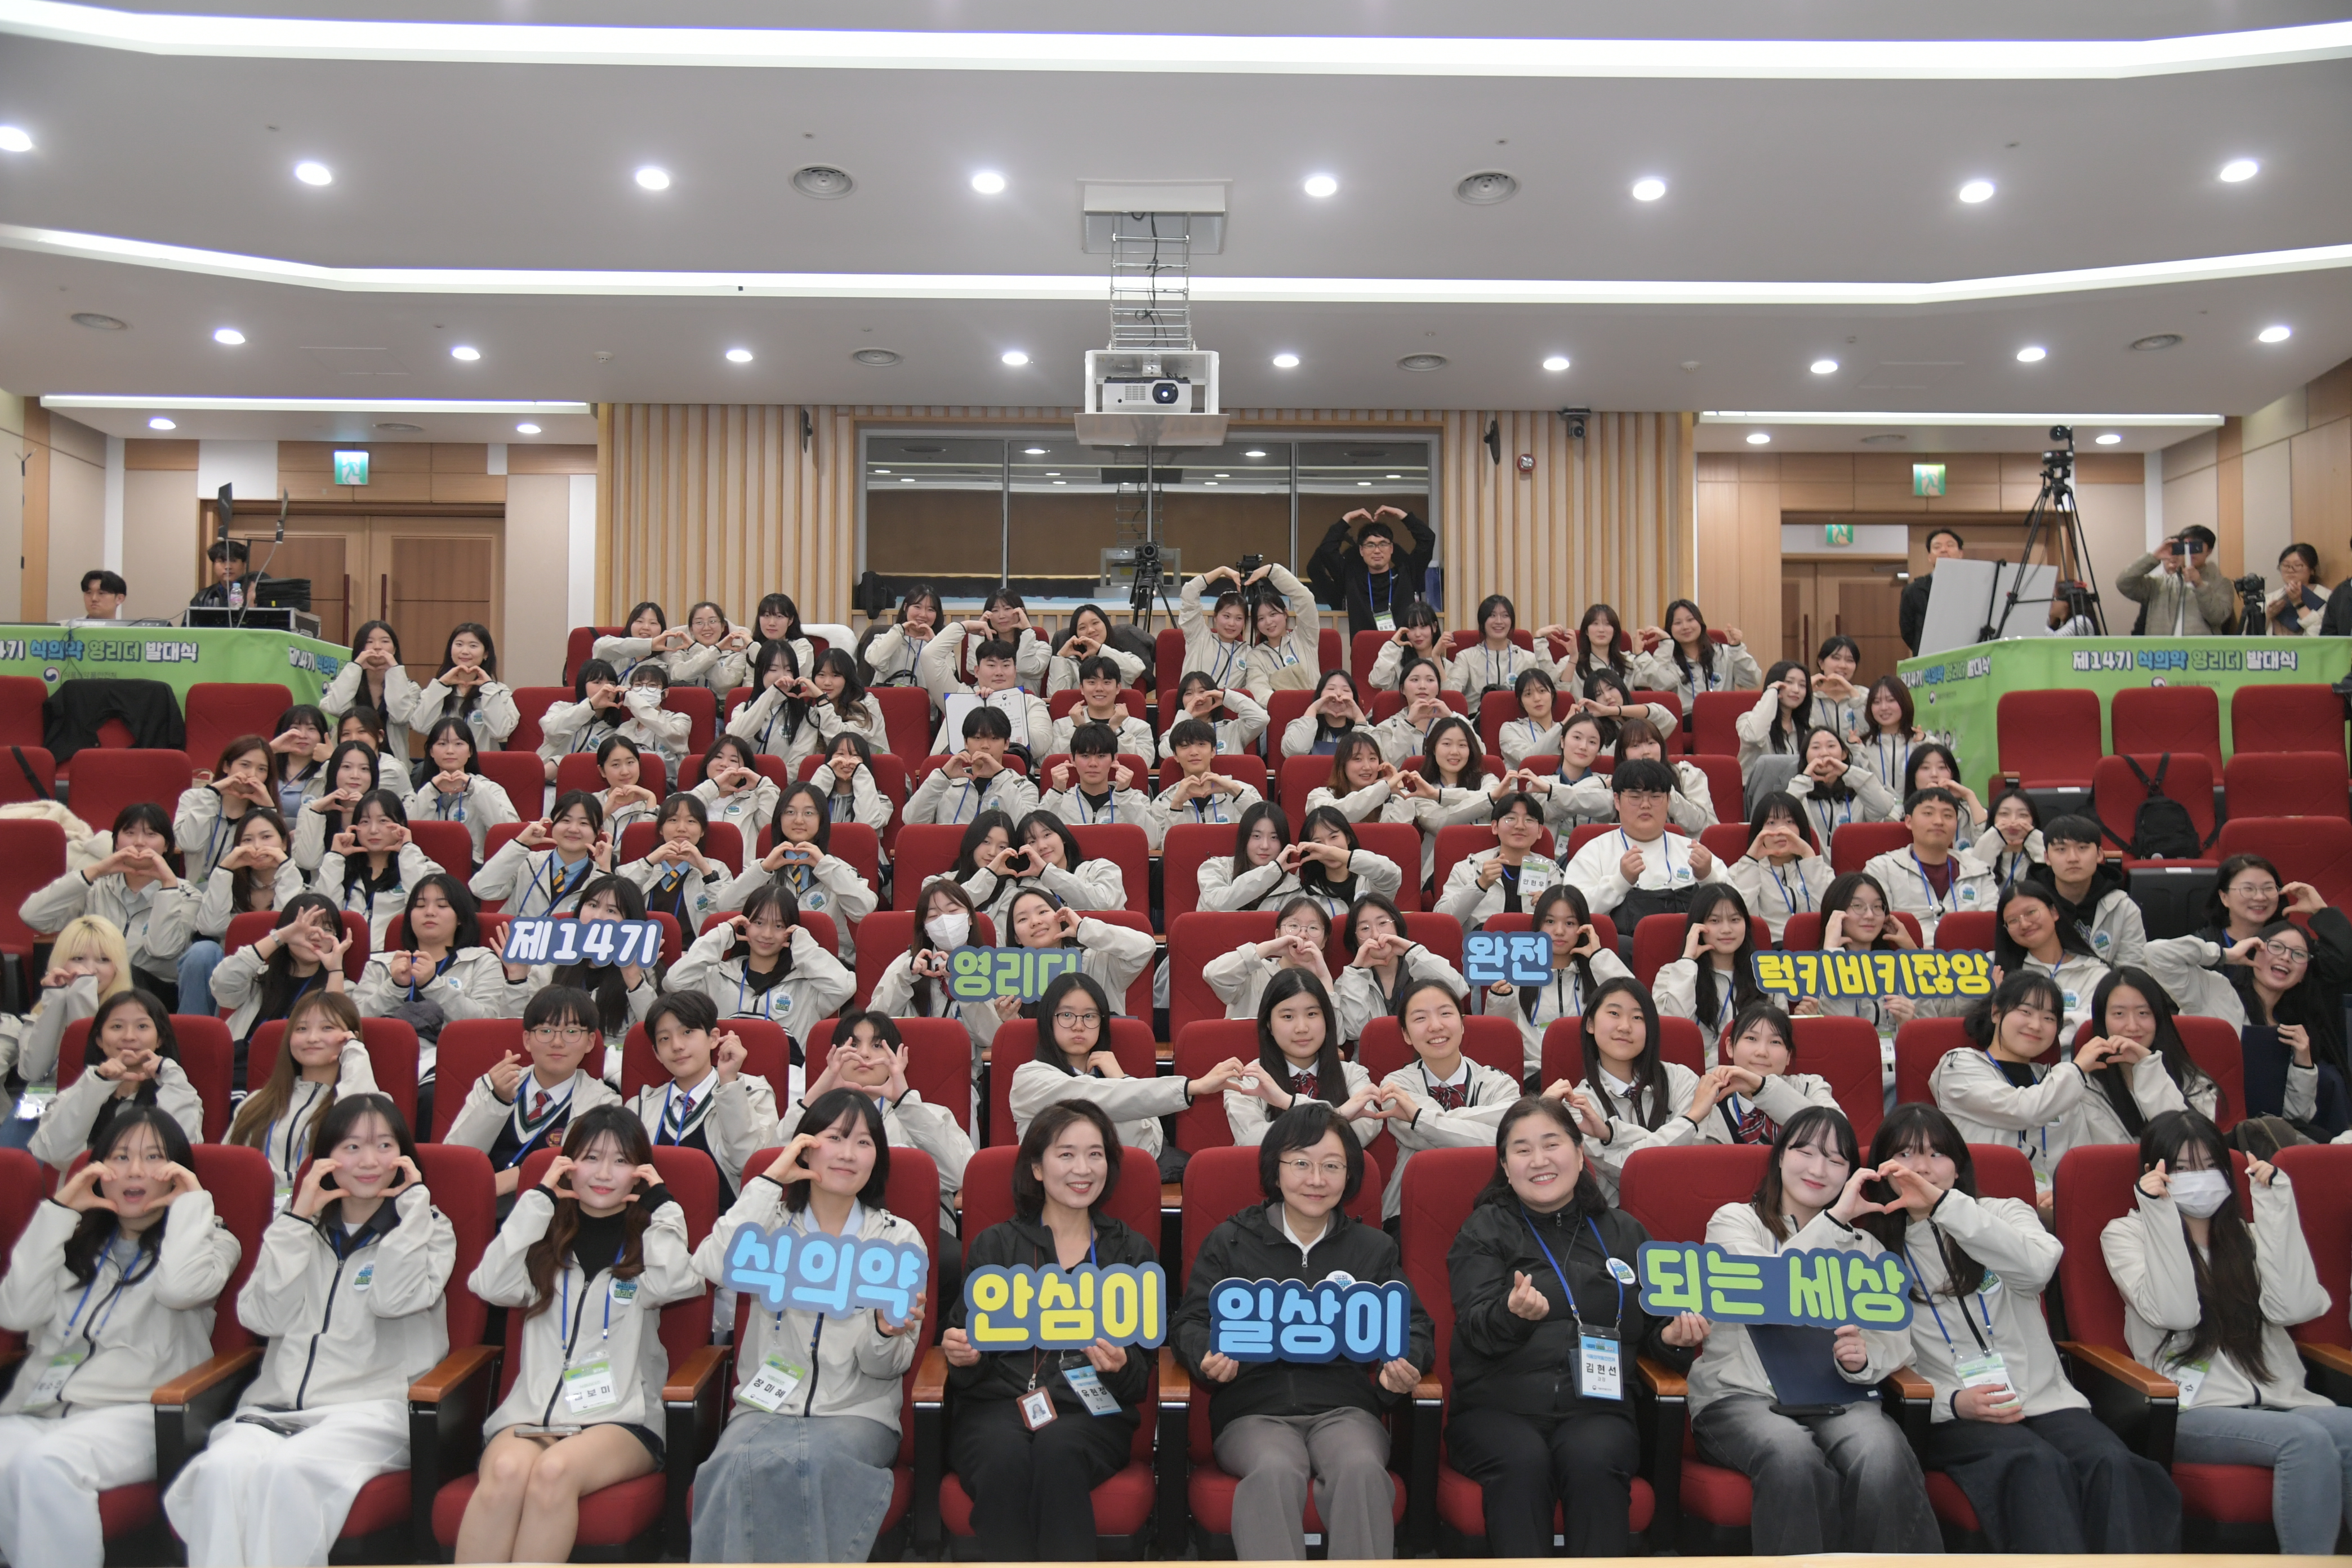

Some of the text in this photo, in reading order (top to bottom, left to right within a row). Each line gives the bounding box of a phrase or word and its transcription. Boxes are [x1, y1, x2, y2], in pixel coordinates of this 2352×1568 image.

[30, 640, 84, 661] 식의약
[88, 640, 141, 662] 영리더
[145, 642, 198, 662] 발대식
[1967, 655, 1991, 678] 발대식
[2072, 650, 2297, 671] 제14기 식의약 영리더 발대식
[507, 920, 657, 964] 제14기
[1468, 936, 1548, 981] 완전
[1757, 953, 1991, 996] 럭키비키잖앙
[731, 1230, 921, 1318] 식의약
[1646, 1249, 1905, 1322] 되는 세상
[972, 1270, 1158, 1342] 안심이
[1217, 1287, 1402, 1357] 일상이
